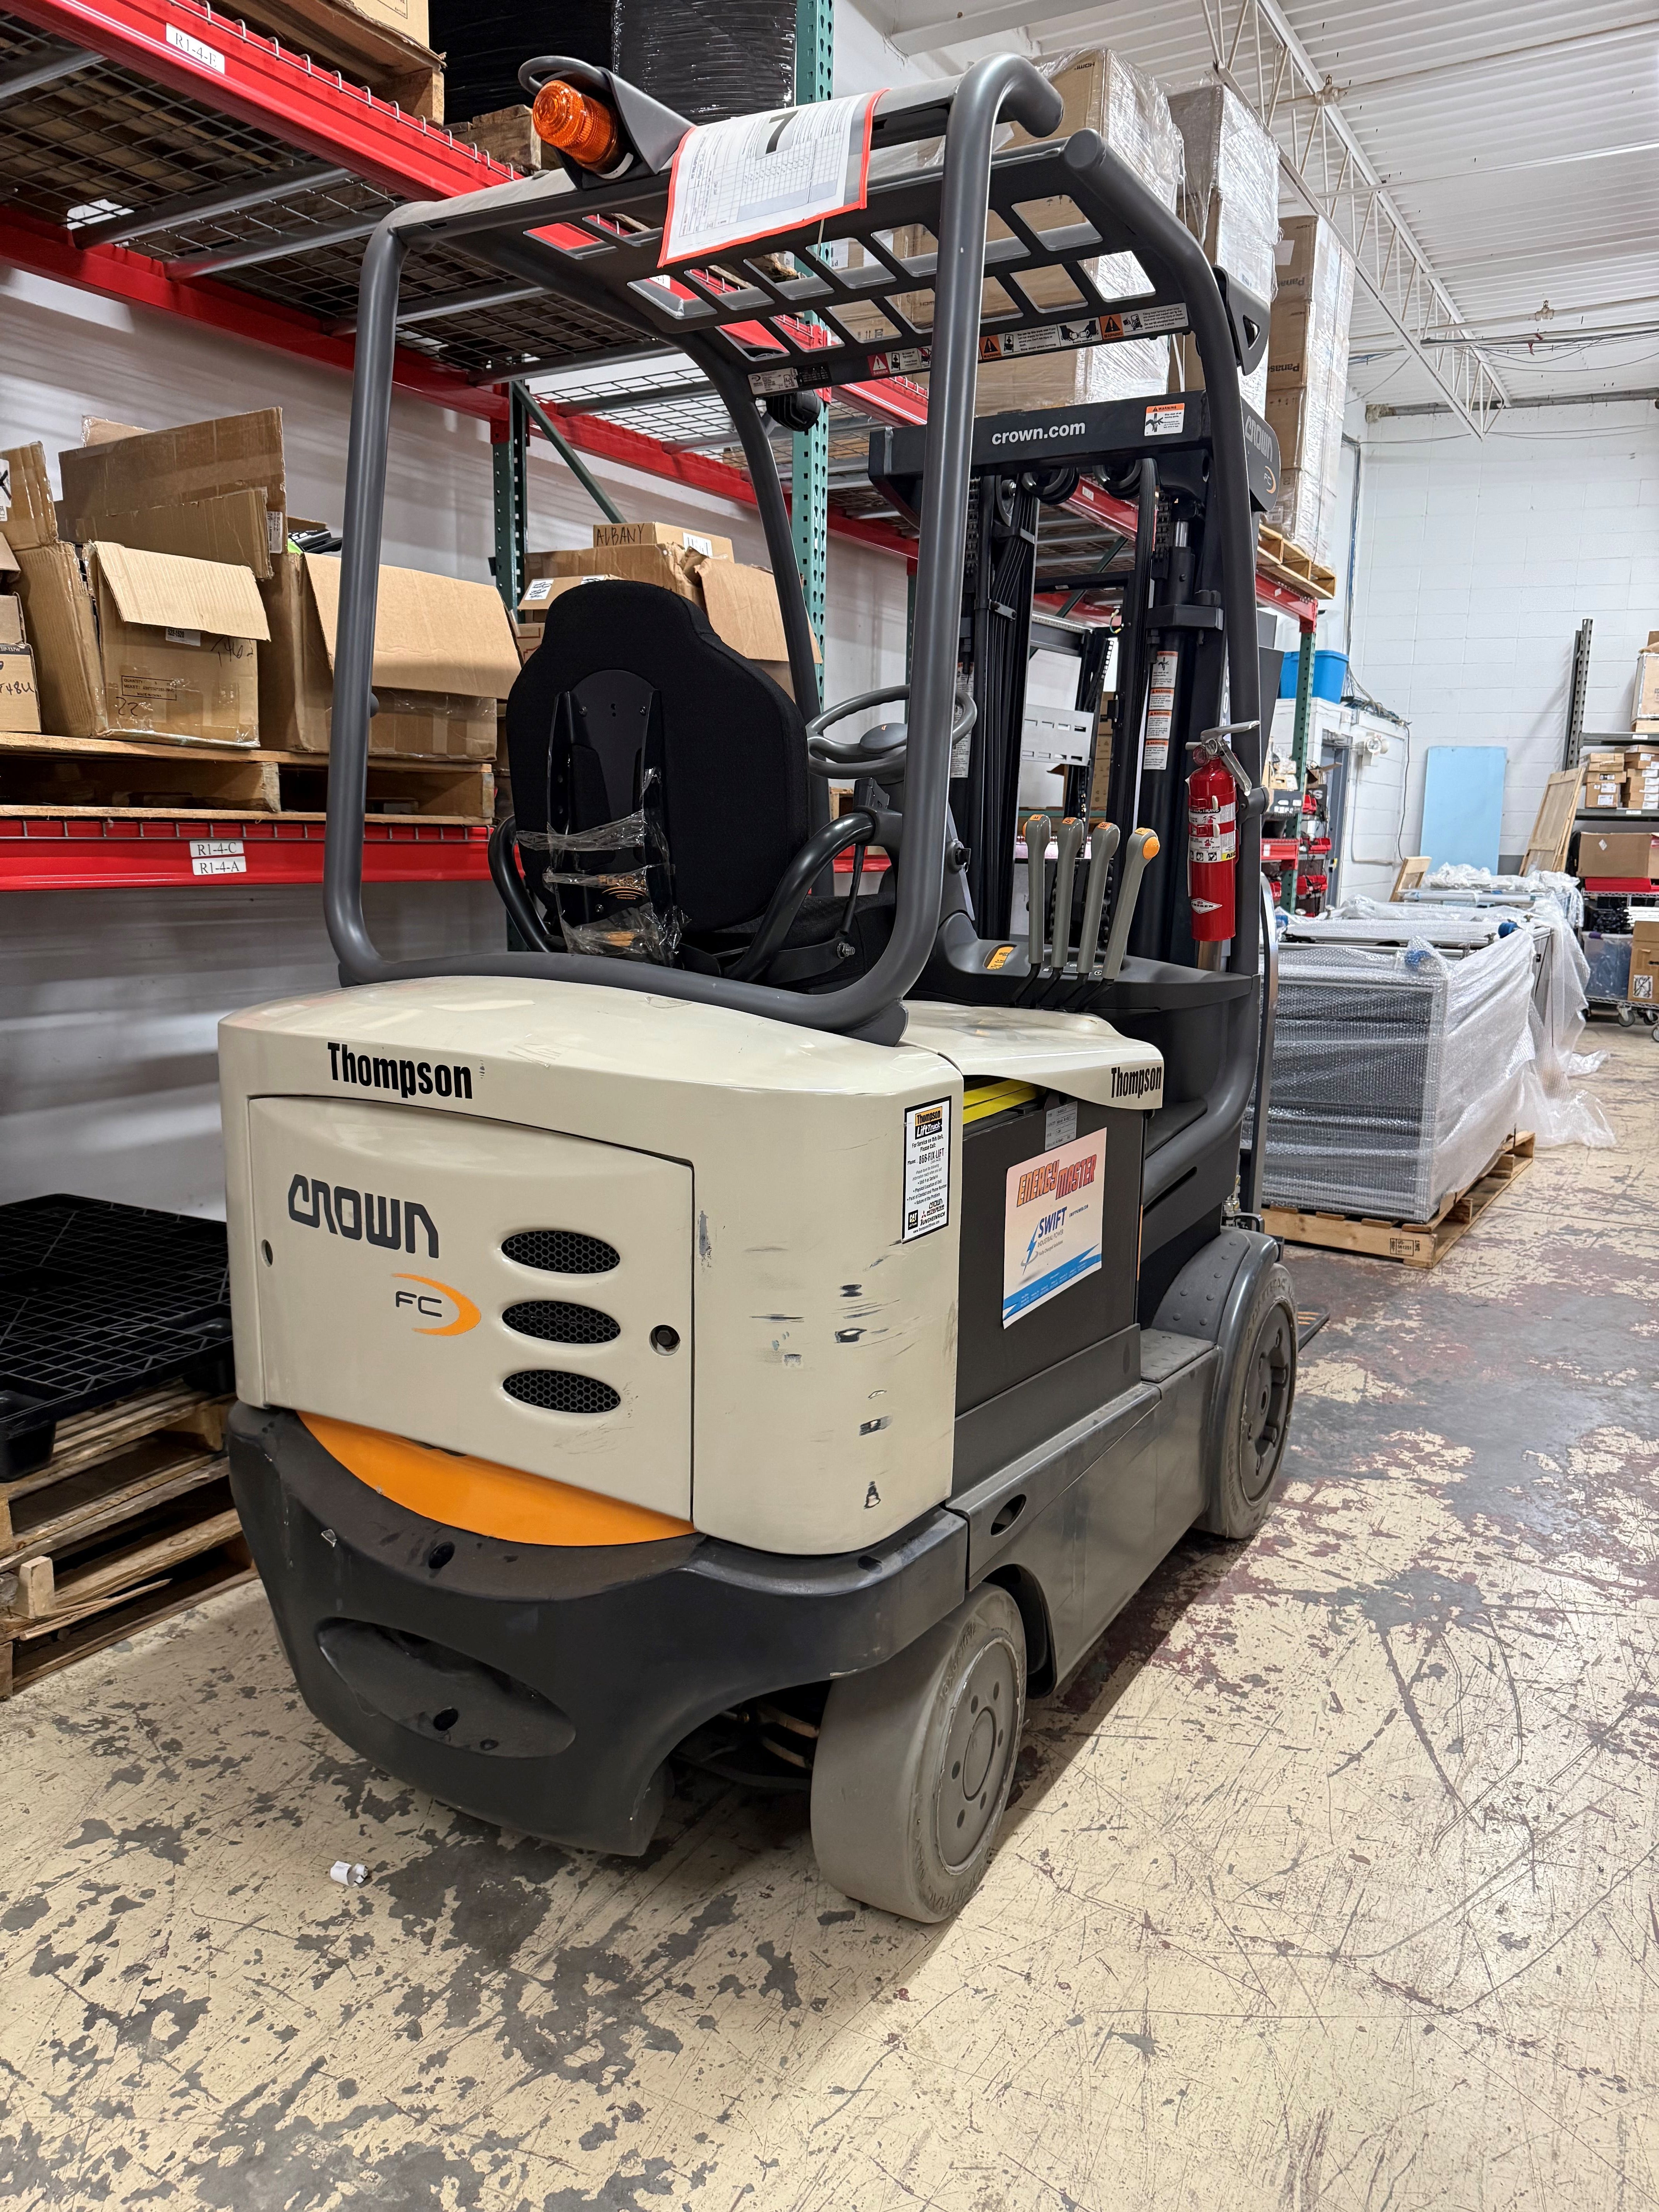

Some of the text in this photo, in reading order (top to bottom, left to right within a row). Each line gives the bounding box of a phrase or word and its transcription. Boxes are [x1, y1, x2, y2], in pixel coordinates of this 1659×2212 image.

[175, 32, 217, 67] R1-4-E
[765, 110, 798, 155] 7
[991, 422, 1085, 445] crown.com
[1245, 415, 1273, 462] CROWN
[1264, 472, 1272, 486] FC
[596, 523, 645, 546] ALBANY
[197, 842, 237, 855] R1-4-C
[200, 861, 240, 874] R1-4-A
[327, 1041, 472, 1099] Thompson
[1111, 1066, 1162, 1099] Thompson
[917, 1110, 941, 1125] Thompson
[1017, 1154, 1097, 1207] ENERGY MASTER
[288, 1174, 439, 1259] CROWN
[1038, 1206, 1067, 1238] SWIFT
[1038, 1229, 1063, 1247] INDUSTRIAL POWER
[395, 1290, 442, 1317] FC
